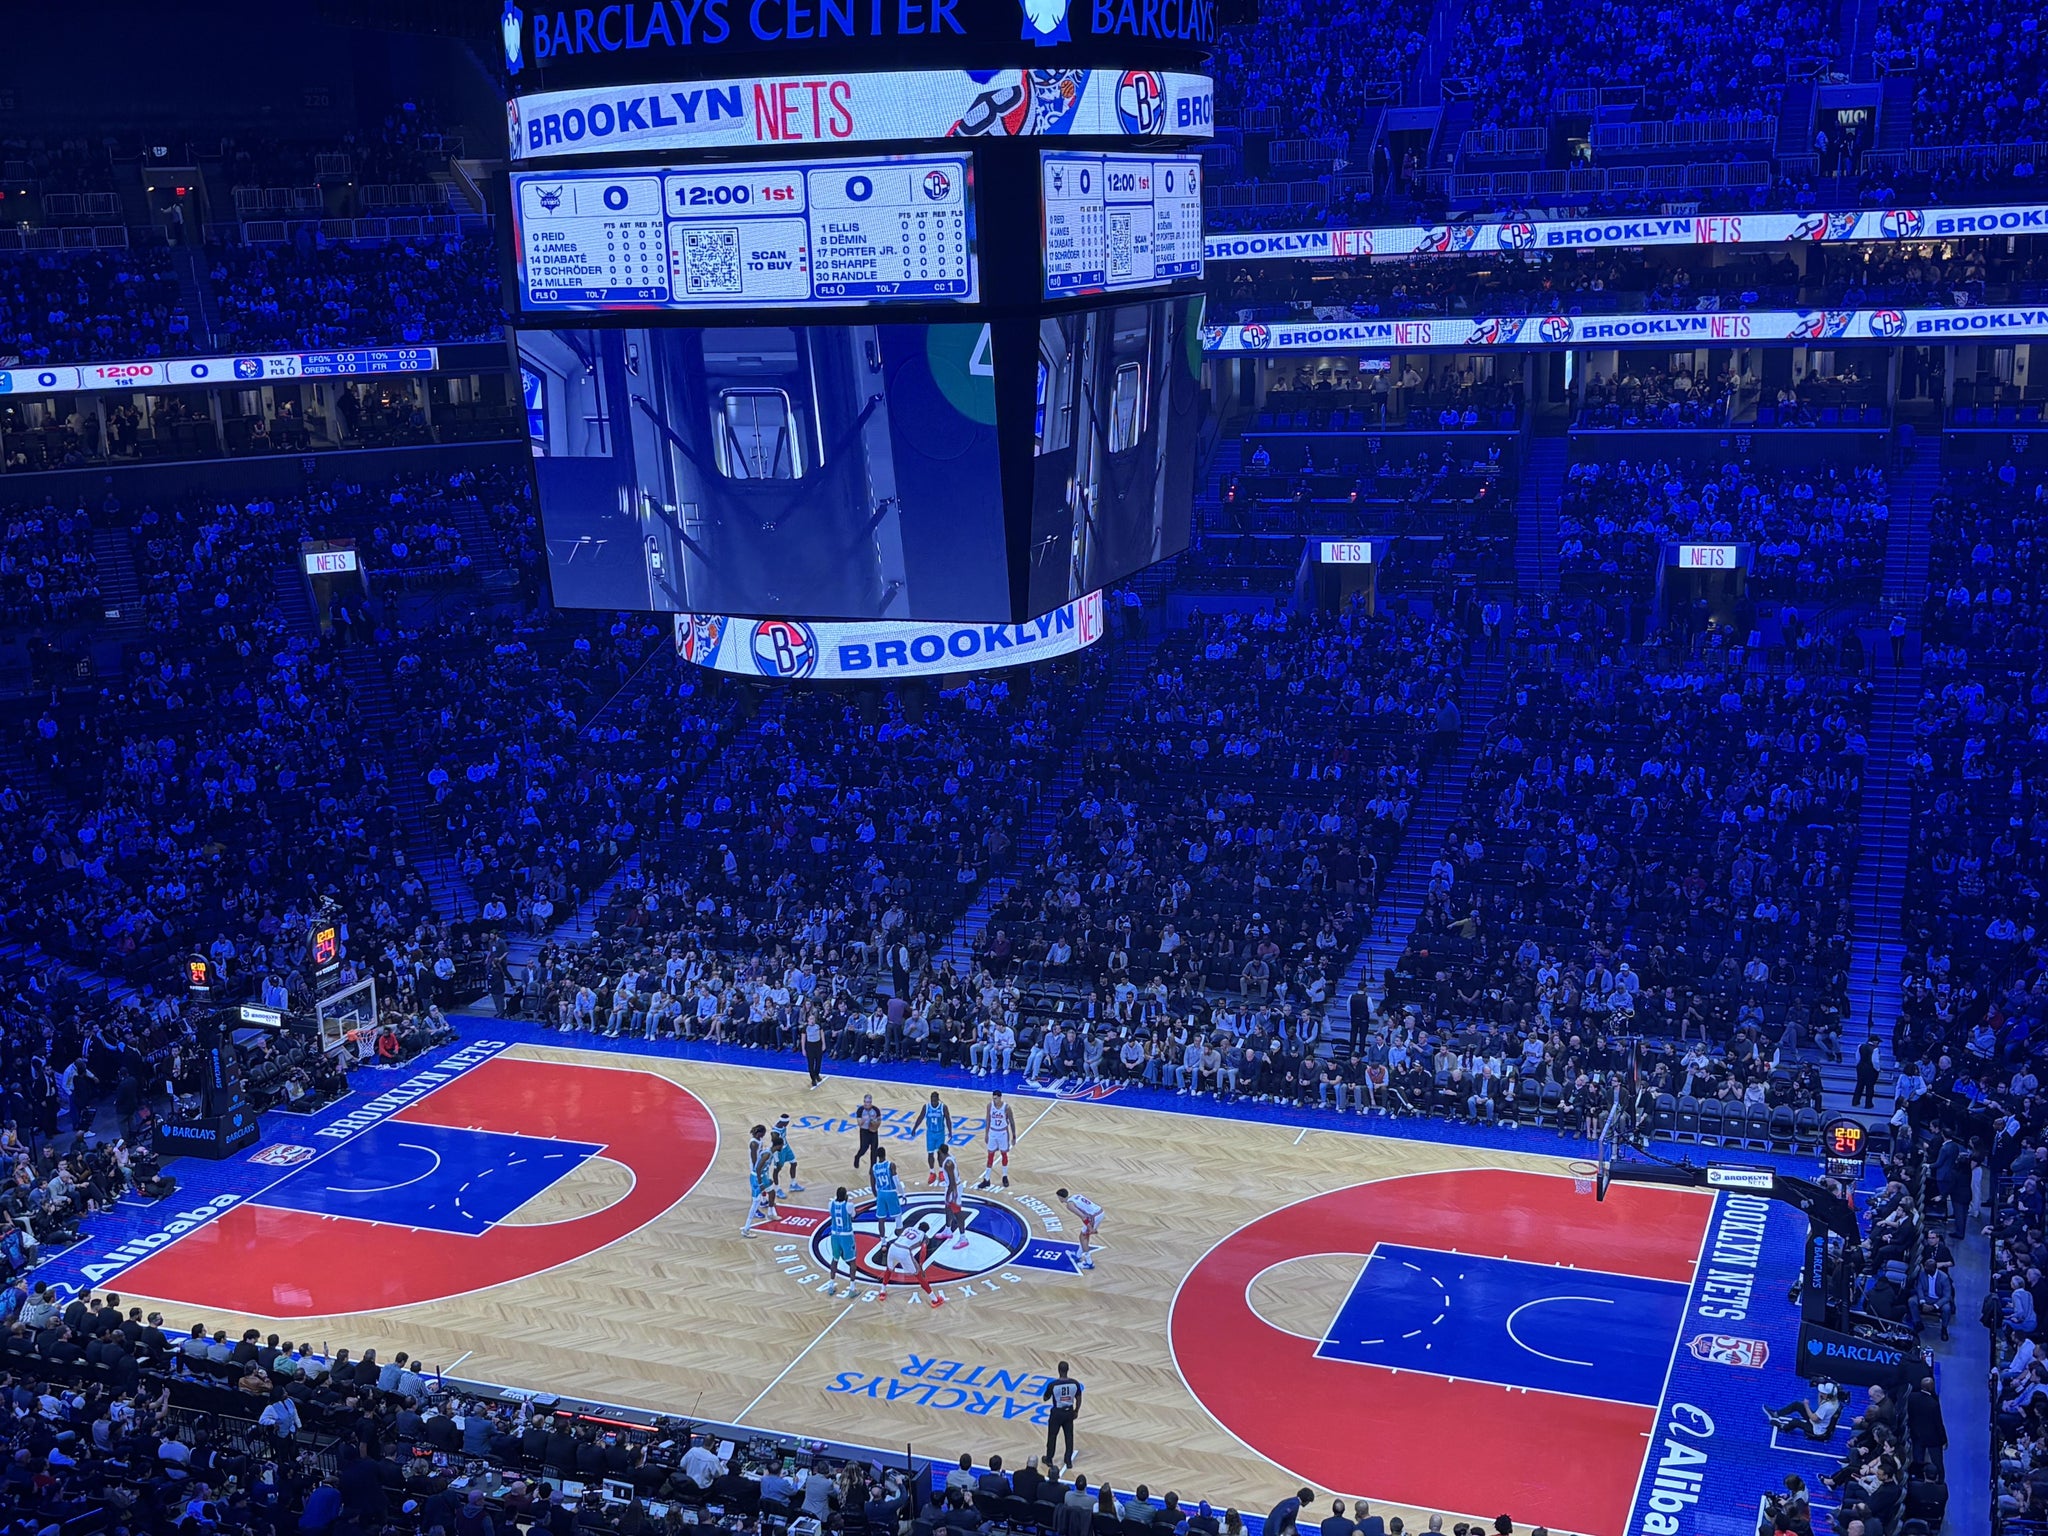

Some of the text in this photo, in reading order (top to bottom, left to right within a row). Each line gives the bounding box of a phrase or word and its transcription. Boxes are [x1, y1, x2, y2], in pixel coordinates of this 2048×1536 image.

[533, 0, 967, 58] BARCLAYS CENTER
[1091, 0, 1214, 43] BARCLAYS
[528, 81, 854, 151] BROOKLYN NETS
[1177, 94, 1213, 129] BRO
[845, 175, 873, 202] 0
[1080, 168, 1091, 195] 0
[1107, 173, 1136, 192] 12:00
[1138, 176, 1150, 190] 1st
[1165, 170, 1174, 193] 0
[603, 185, 629, 211] 0
[675, 185, 750, 207] 12:00
[762, 185, 795, 202] 1st
[533, 230, 661, 241] 0 REID 0 0 0 0
[822, 223, 860, 233] 1 ELLIS
[1547, 217, 1742, 246] BROOKLYN NETS
[542, 244, 577, 252] JAMES
[608, 242, 615, 251] 0
[623, 242, 630, 250] 0
[640, 242, 646, 250] 0
[656, 242, 662, 250] 0
[821, 234, 867, 245] 8 DËMIN
[1204, 236, 1328, 259] BROOKLYN
[1331, 230, 1374, 257] NETS
[530, 253, 663, 265] 14 DIABATÉ 0 0 0 0
[752, 250, 787, 260] SCAN
[817, 246, 898, 257] 17 PORTER JR.
[531, 265, 602, 276] 17 SCHRÖDER
[747, 261, 793, 271] TO BUY
[815, 259, 877, 270] 20 SHARPE
[531, 278, 583, 287] 24 MILLER
[816, 271, 878, 282] 30 RANDLE
[550, 290, 558, 300] 0
[585, 291, 599, 299] TOL
[600, 290, 608, 300] 7
[651, 289, 657, 299] 1
[837, 285, 846, 295] 0
[892, 283, 900, 293] 7
[948, 282, 954, 292] 1
[1583, 316, 1750, 340] BROOKLYN NETS
[1916, 310, 2048, 334] BROOKLYN
[1278, 323, 1432, 346] BROOKLYN NETS
[286, 357, 294, 367] 7
[337, 353, 355, 362] 0.0
[371, 350, 417, 360] TO% 0.0
[96, 365, 153, 378] 12:00
[191, 364, 209, 378] 0
[287, 367, 296, 376] 0
[304, 363, 356, 375] OREB% 0.0
[400, 361, 418, 370] 0.0
[38, 372, 57, 387] 0
[115, 378, 134, 386] 1st
[1331, 544, 1361, 562] NETS
[1691, 548, 1724, 566] NETS
[316, 553, 346, 571] NETS
[838, 604, 1075, 672] BROOKLYN
[316, 927, 335, 943] 12:00
[316, 938, 336, 963] 24
[192, 970, 205, 981] 24
[314, 1040, 506, 1139] BROOKLYN NETS
[850, 1105, 987, 1131] CETE
[931, 1117, 938, 1125] 4
[172, 1126, 216, 1141] BARCLAYS
[225, 1123, 255, 1144] BARCLAYS
[791, 1115, 975, 1146] BRCAYS
[1834, 1127, 1861, 1139] 12:00
[1835, 1138, 1856, 1152] 24
[1724, 1174, 1769, 1182] BROOKLYN
[780, 1214, 818, 1227] 1967
[1042, 1217, 1064, 1233] NEW
[80, 1194, 242, 1282] Alibaba
[1032, 1248, 1062, 1261] EST.
[1698, 1193, 1770, 1321] ROOKLYN NETS
[773, 1243, 880, 1303] SEASONS
[1812, 1247, 1822, 1290] BARCLAYS
[1826, 1342, 1903, 1366] BARCLAYS
[900, 1353, 1085, 1398] ENTER
[825, 1371, 1053, 1427] BARCLAYS
[1642, 1439, 1708, 1536] Aliba
